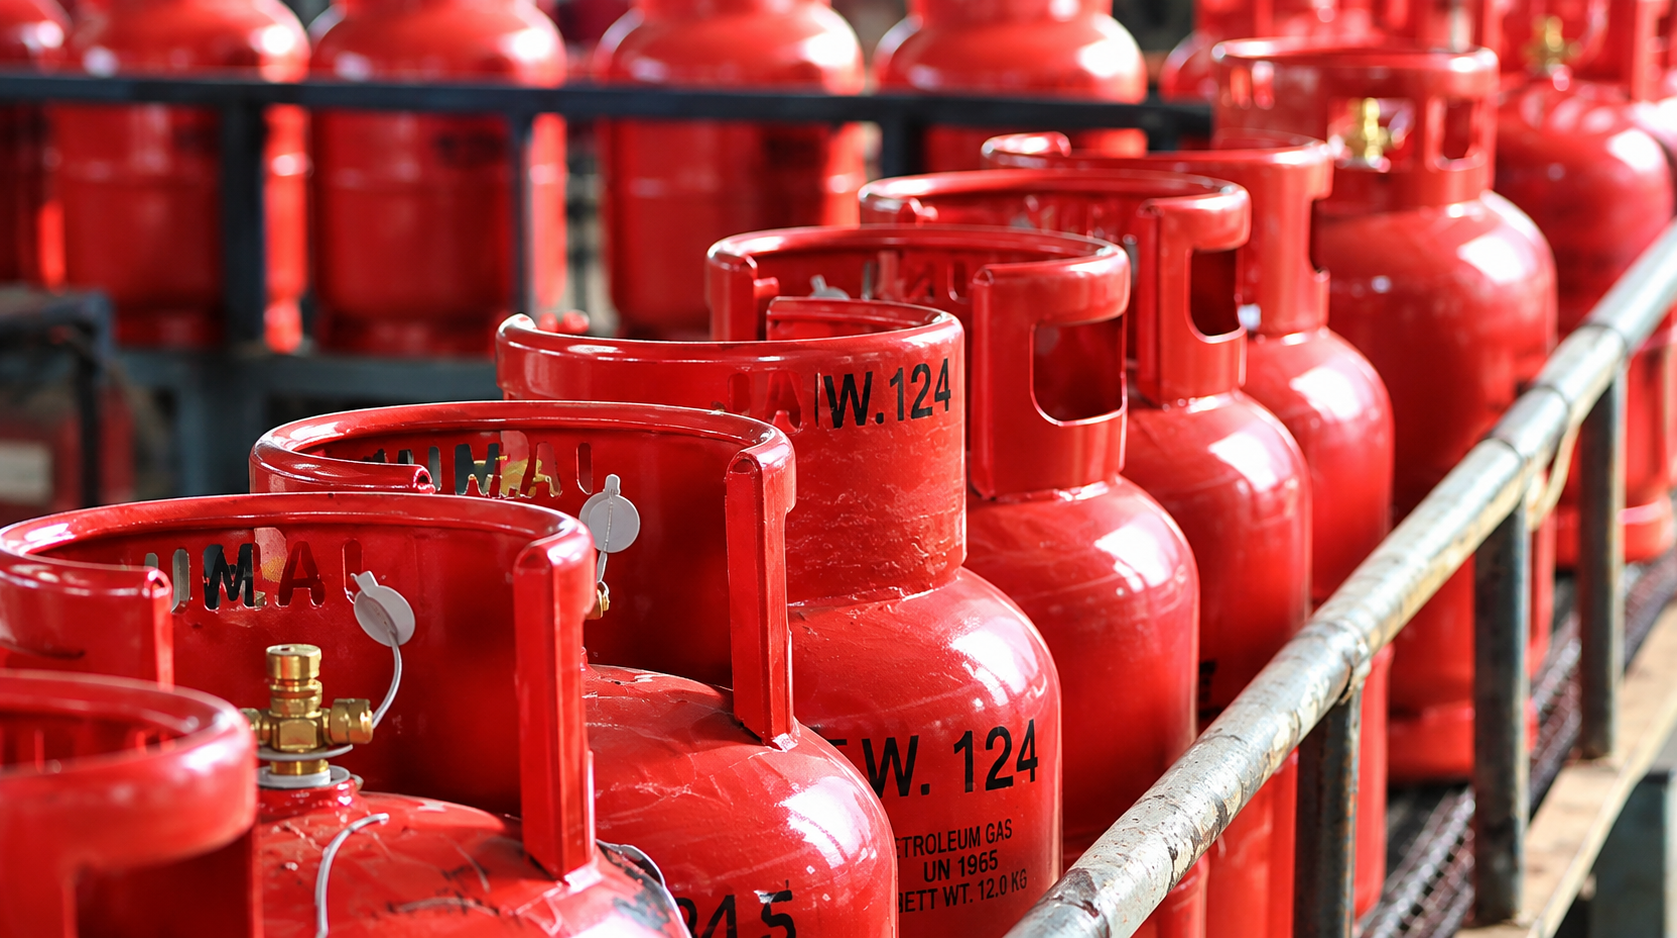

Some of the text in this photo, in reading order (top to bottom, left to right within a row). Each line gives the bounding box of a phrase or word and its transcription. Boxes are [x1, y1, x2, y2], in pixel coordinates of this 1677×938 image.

[823, 358, 952, 429] W.124
[953, 718, 1038, 793] 124
[985, 818, 1013, 845] GAS
[923, 849, 999, 883] UN 1965
[942, 882, 974, 907] WT.
[977, 874, 1008, 901] 12.0
[1011, 868, 1028, 893] KG
